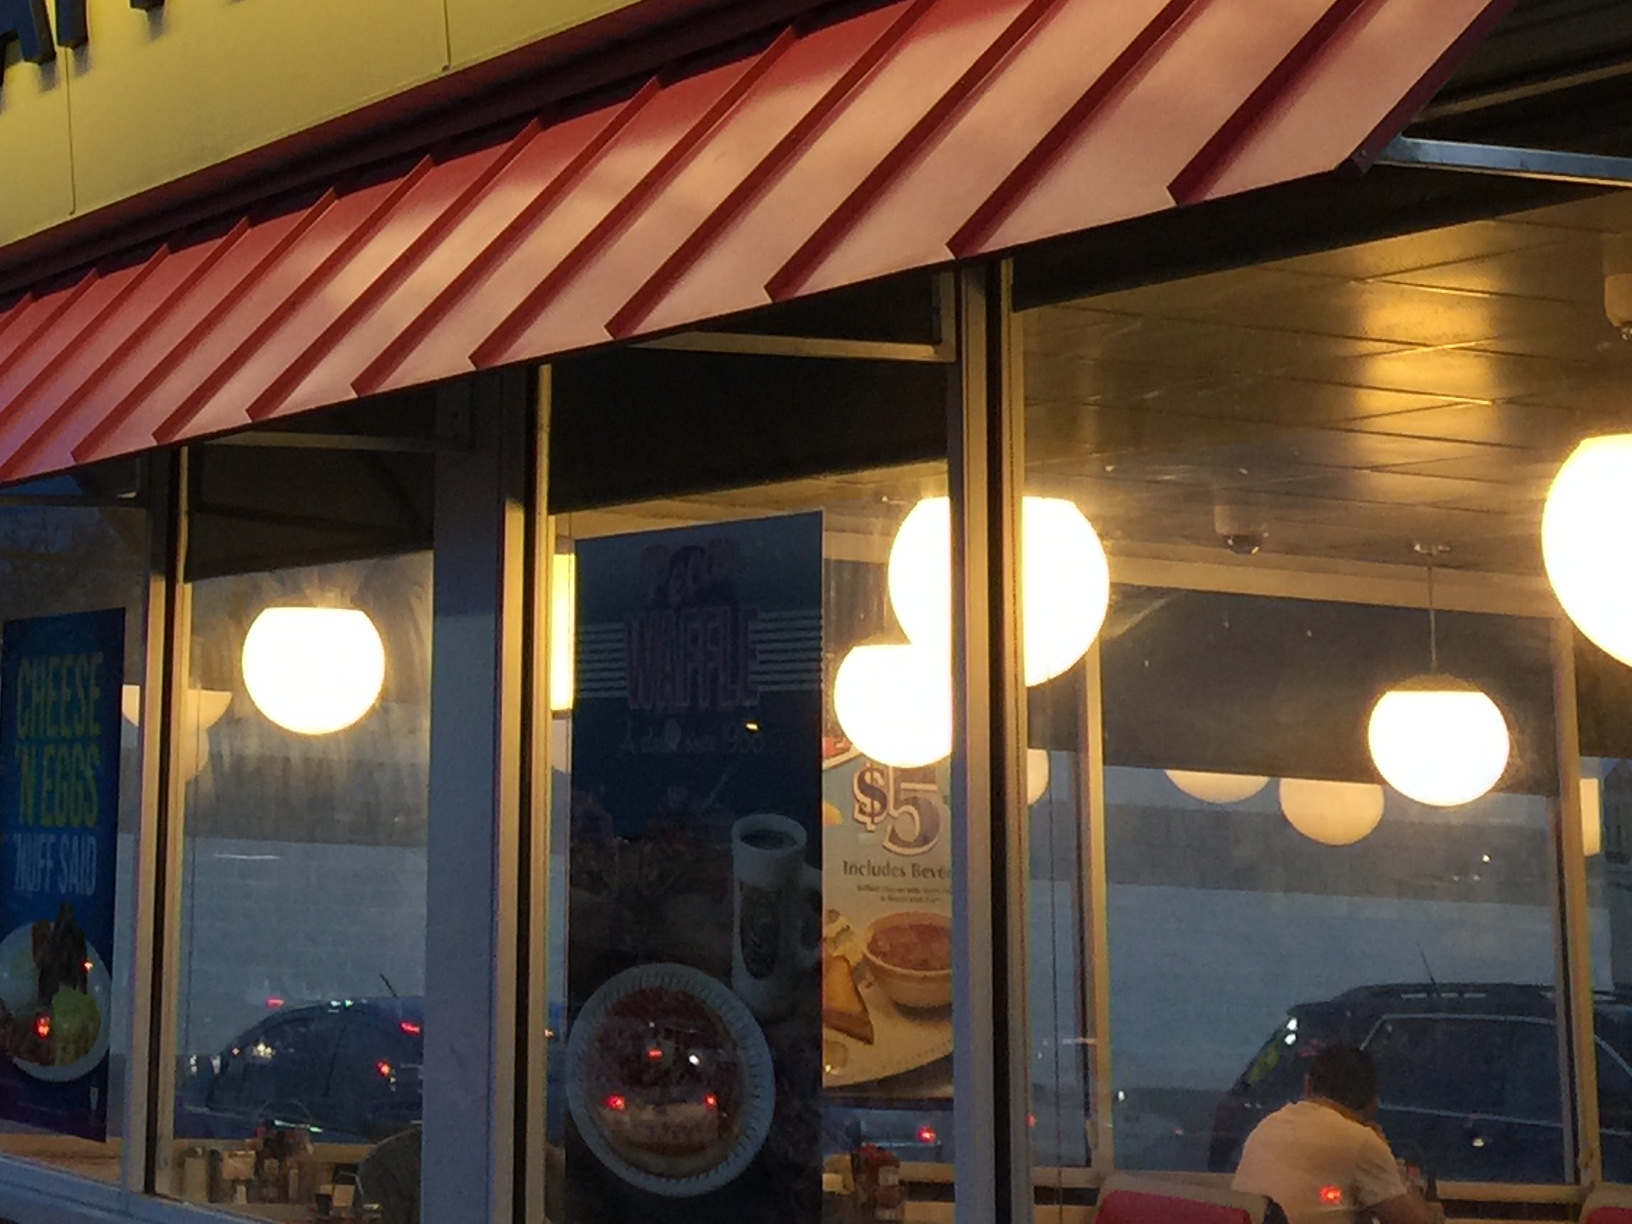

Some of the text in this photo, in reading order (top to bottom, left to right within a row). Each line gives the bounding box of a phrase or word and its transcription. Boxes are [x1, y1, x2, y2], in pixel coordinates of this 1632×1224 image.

[16, 650, 104, 740] CHEESE
[40, 740, 102, 828] EGGS
[853, 762, 941, 857] $5
[58, 833, 98, 897] SAID
[842, 859, 954, 880] Includes Beve
